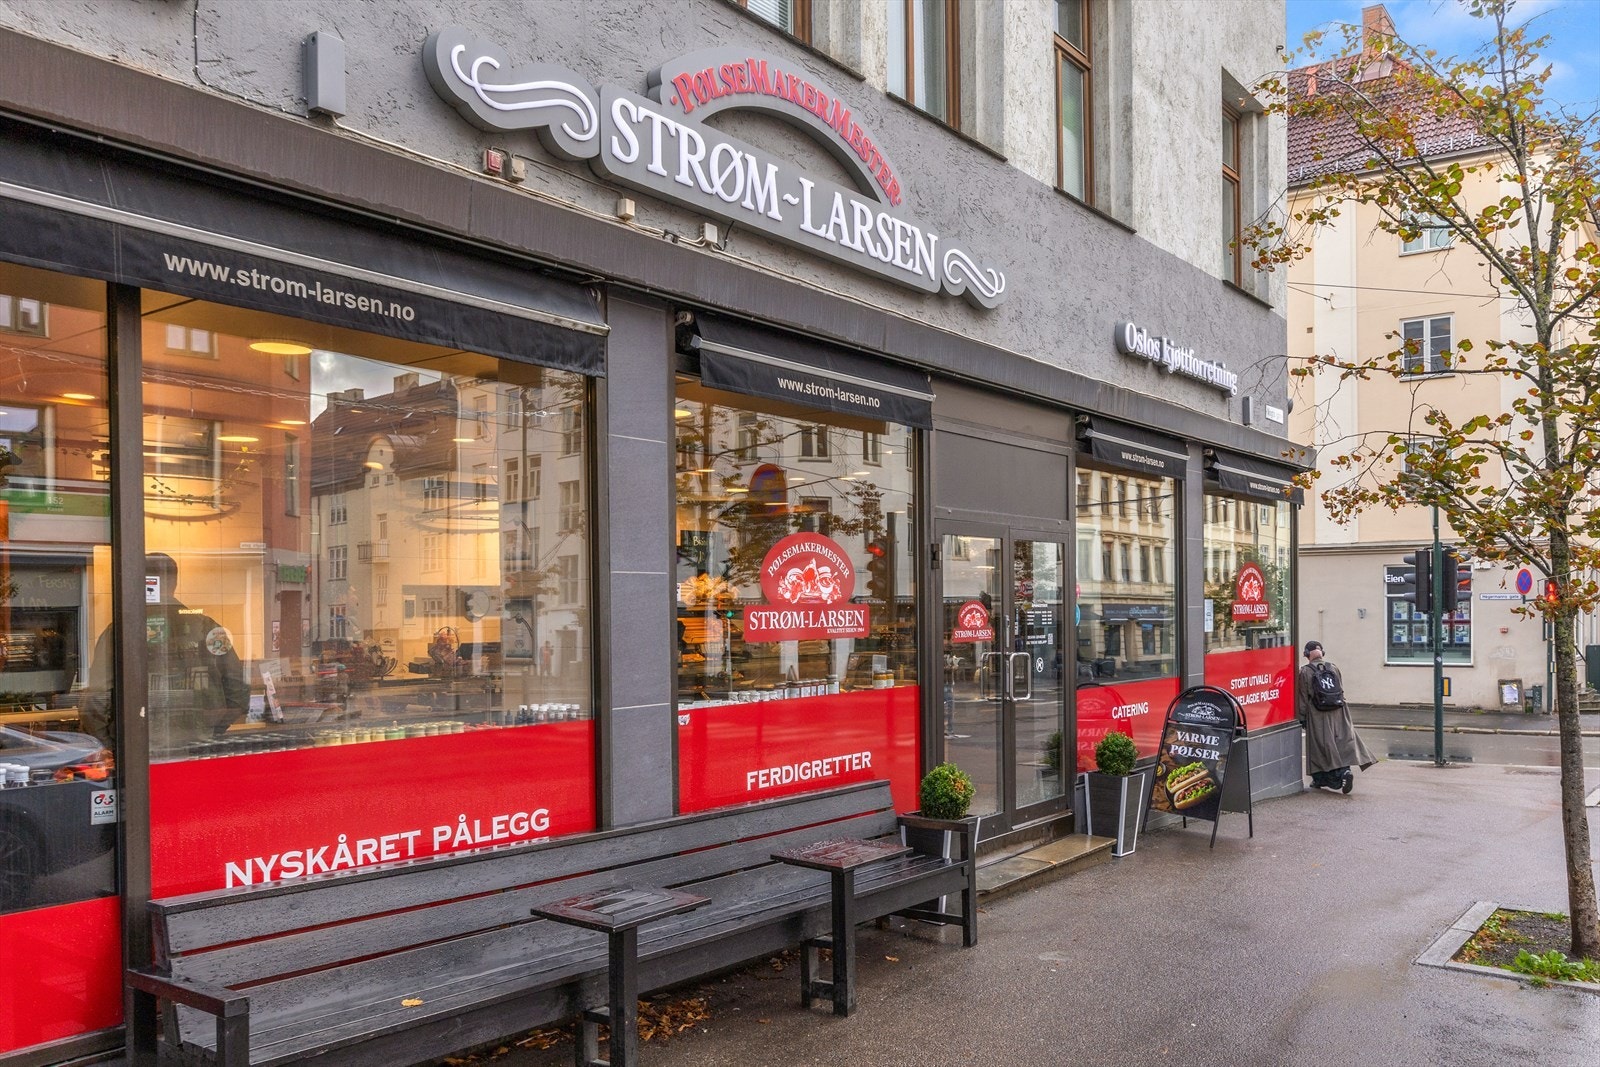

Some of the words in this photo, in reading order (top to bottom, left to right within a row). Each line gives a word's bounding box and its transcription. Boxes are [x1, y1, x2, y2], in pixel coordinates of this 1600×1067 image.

[163, 252, 416, 322] www.strom-larsen.no
[1125, 322, 1161, 360] Oslos
[1162, 337, 1238, 396] kjøttforretning
[777, 377, 881, 408] www.strom-larsen.no
[1120, 450, 1165, 469] www.strom-larsen.no
[767, 541, 851, 579] PØLSEMAKERMESTER
[1384, 574, 1406, 583] Eien
[749, 609, 865, 630] STRØM-LARSEN
[1230, 676, 1249, 690] STORT
[1248, 674, 1269, 687] UTVALG
[1260, 689, 1280, 702] PØLSER
[1111, 701, 1149, 720] CATERING
[1176, 731, 1220, 746] VARME
[1169, 744, 1220, 761] PØLSER
[746, 751, 872, 791] FERDIGRETTER
[224, 833, 422, 889] NYSKÅRET
[432, 808, 550, 852] PÅLEGG
